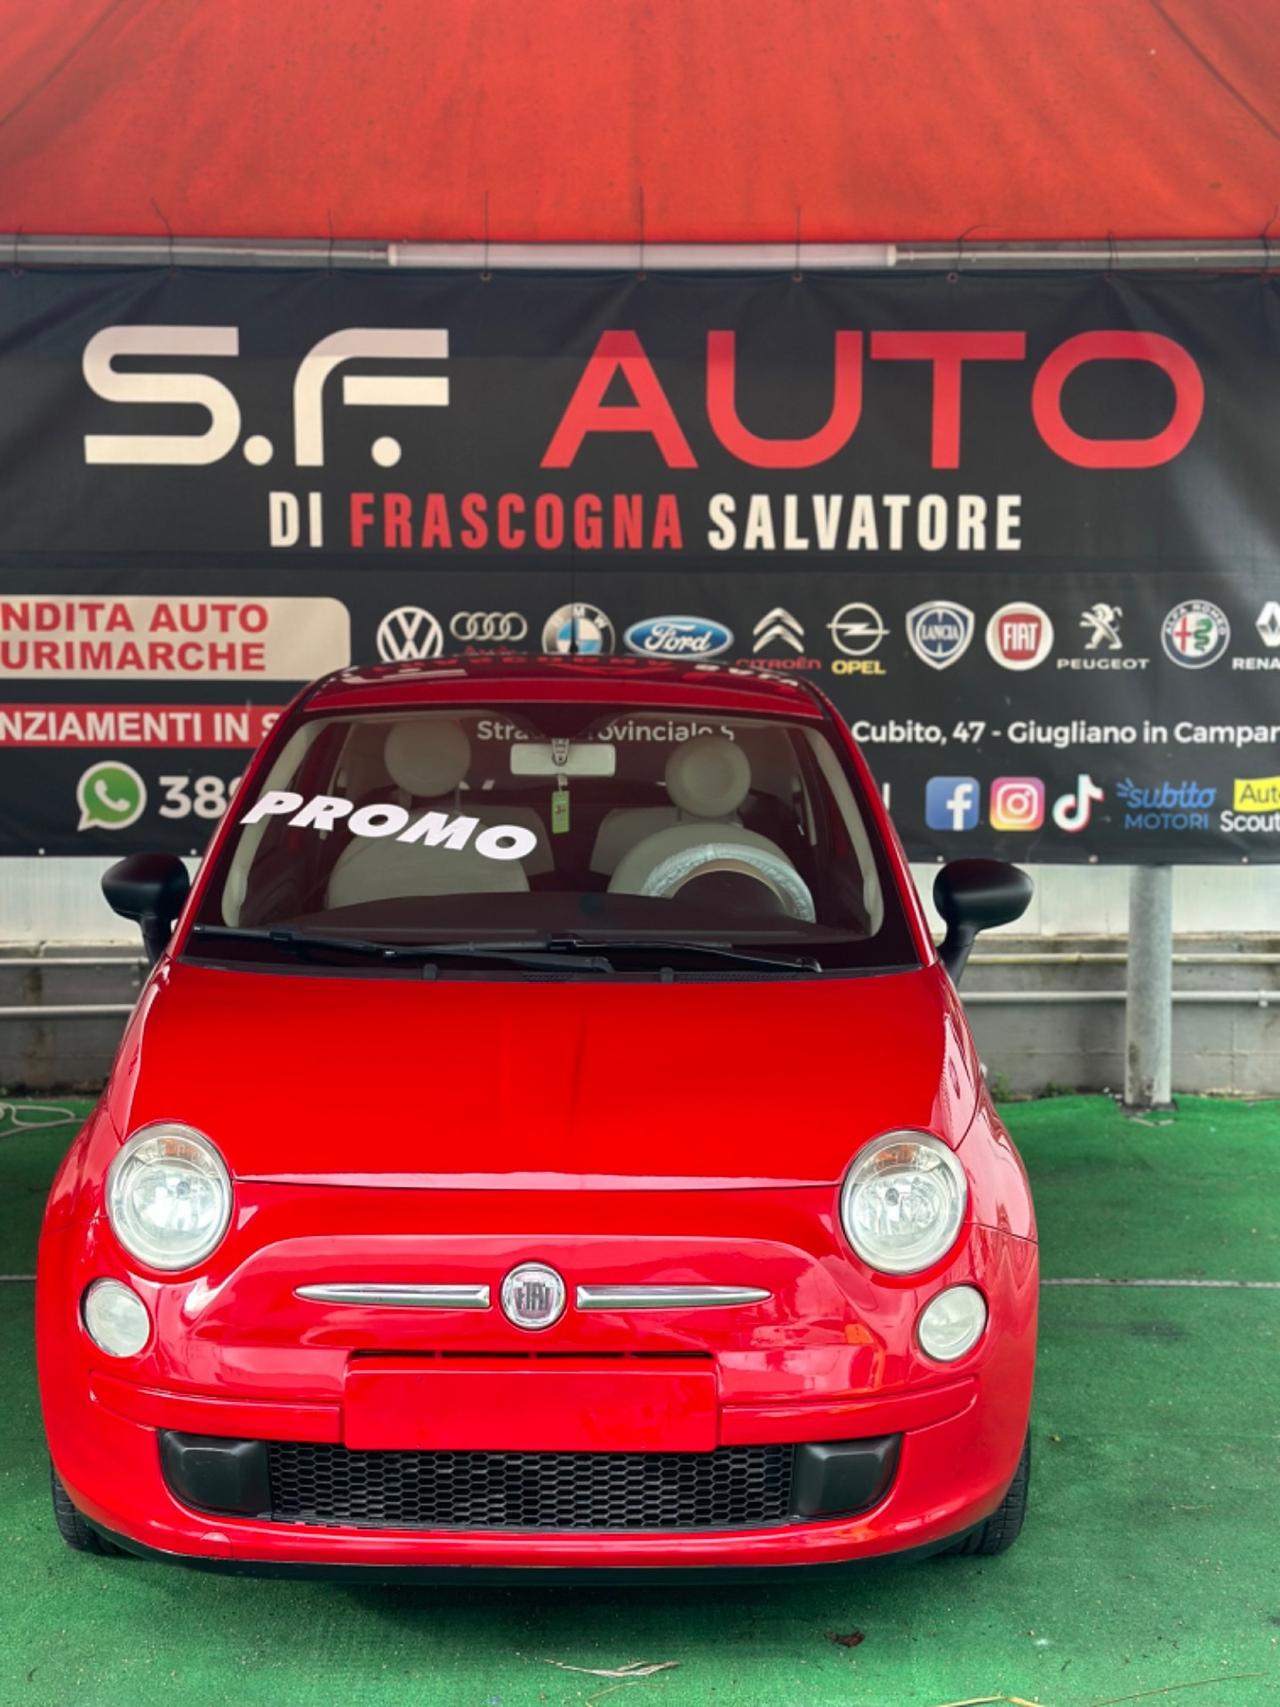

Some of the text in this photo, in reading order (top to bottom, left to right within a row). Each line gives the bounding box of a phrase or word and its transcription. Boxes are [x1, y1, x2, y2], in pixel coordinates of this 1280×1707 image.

[541, 330, 1205, 469] AUTO
[269, 492, 1022, 550] DI FRASCOGNA SALVATORE
[0, 603, 269, 633] NDITA AUTO
[921, 623, 961, 641] LANCIA
[652, 622, 712, 652] Ford
[1003, 622, 1038, 651] FIAT
[0, 641, 266, 672] URIMARCHE
[831, 659, 886, 675] OPEL
[1057, 658, 1150, 670] PEUGEOT
[214, 712, 249, 742] IN
[852, 720, 947, 746] Cubito,
[952, 722, 986, 743] 47
[1007, 720, 1137, 748] Giugliano
[1143, 720, 1168, 743] in
[1126, 781, 1216, 809] subito
[240, 791, 537, 860] PROMO
[1124, 813, 1209, 830] MOTORI
